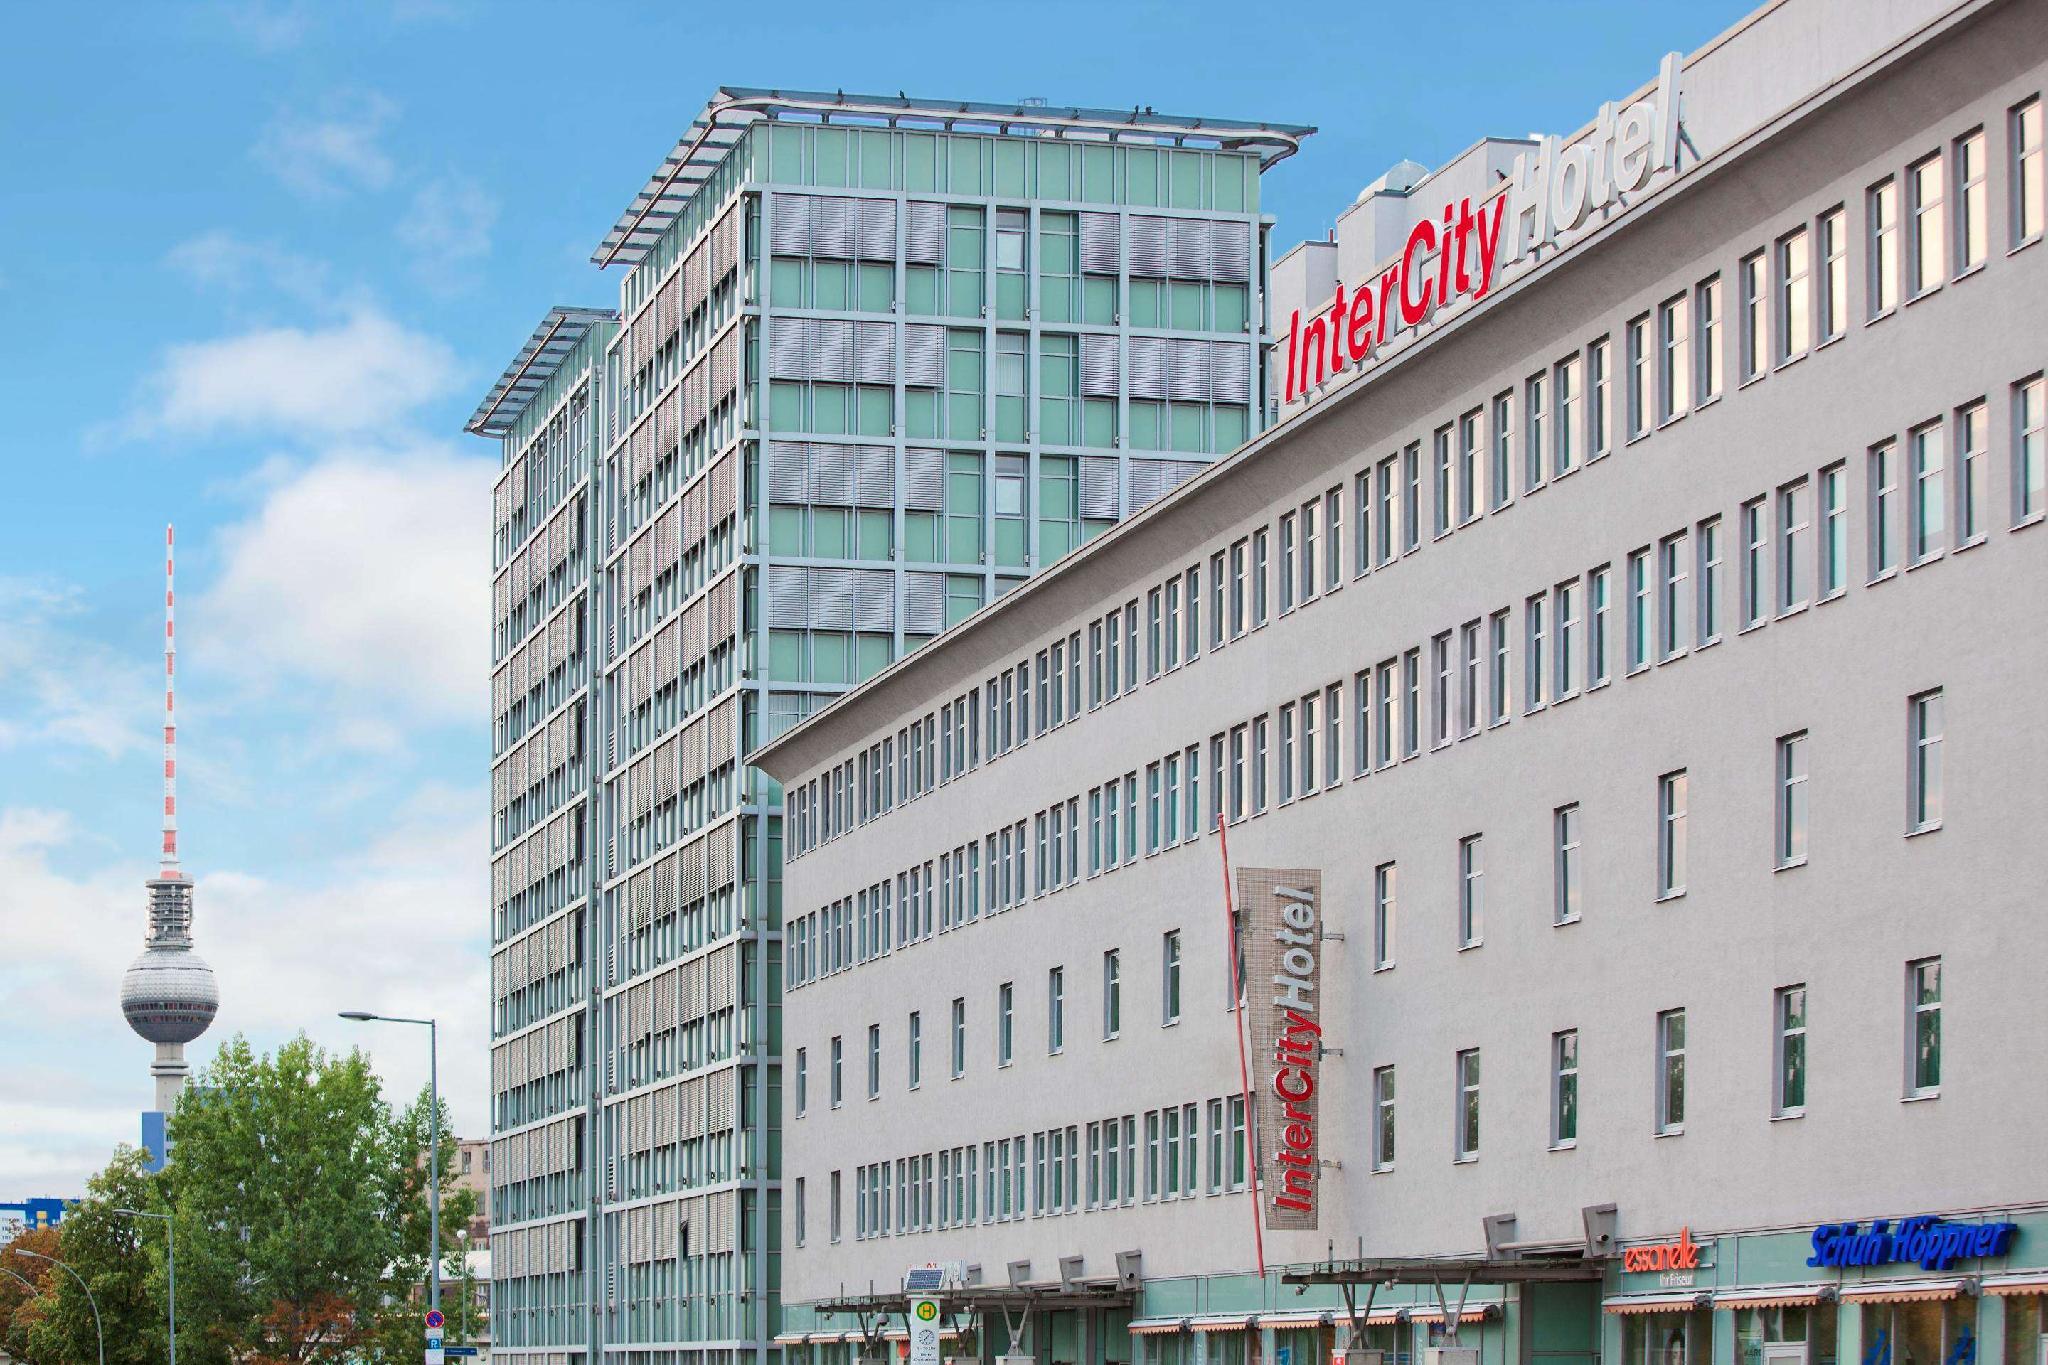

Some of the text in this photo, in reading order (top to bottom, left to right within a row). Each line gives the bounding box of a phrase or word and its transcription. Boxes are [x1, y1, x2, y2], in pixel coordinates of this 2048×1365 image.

[1285, 52, 1683, 404] InterCityHotel
[1271, 885, 1321, 1212] InterCityHotel
[1624, 1226, 1699, 1273] essanelle
[1806, 1215, 2018, 1271] Schuh Höppner
[923, 1305, 932, 1319] H
